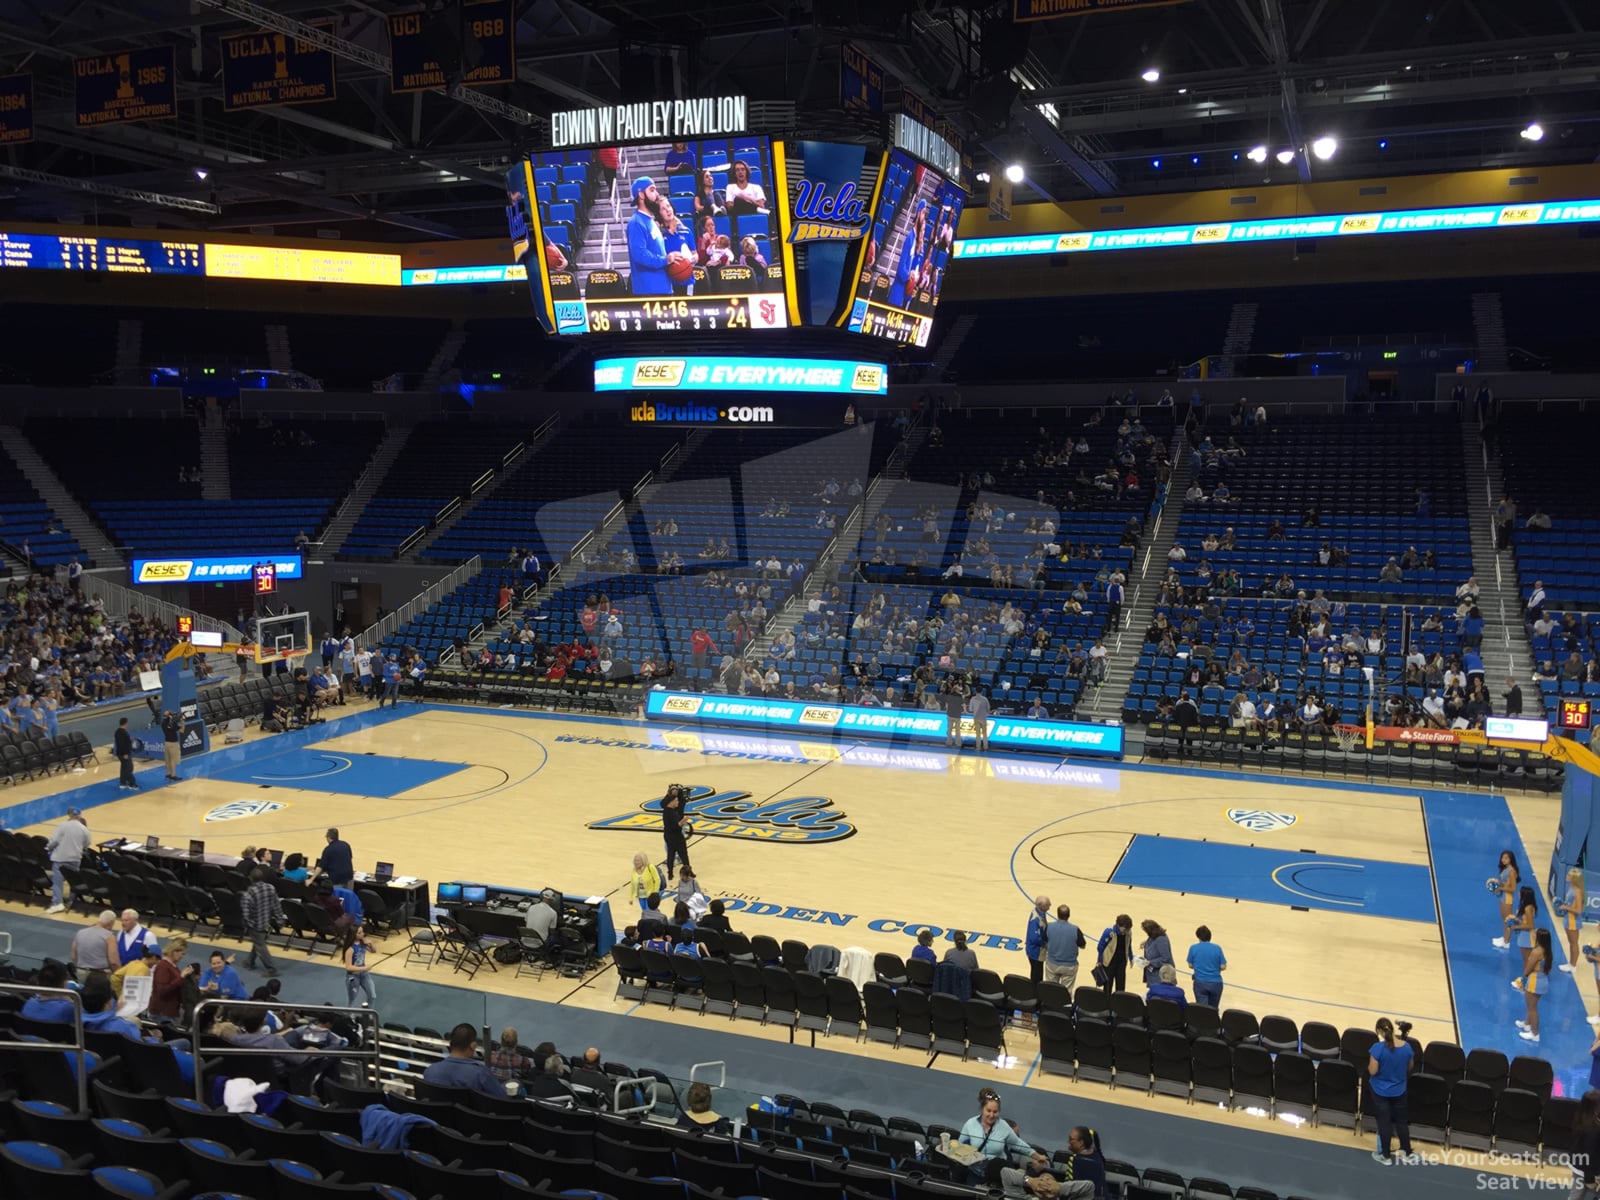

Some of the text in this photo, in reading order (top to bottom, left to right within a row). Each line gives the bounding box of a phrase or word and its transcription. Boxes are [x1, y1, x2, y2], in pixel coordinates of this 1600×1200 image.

[472, 18, 504, 39] 968
[228, 36, 271, 60] UCLA
[77, 56, 114, 77] UCLA
[137, 66, 166, 86] 1965
[402, 70, 445, 88] NATIONAL
[232, 83, 326, 105] NATIONAL CHAMPIONS
[79, 103, 171, 126] NATIONAL CHAMPIONS
[551, 95, 745, 147] EDWIN W PAULEY PAVILION
[795, 179, 865, 222] Ucla
[794, 223, 861, 241] BRUINS
[590, 310, 610, 331] 36
[643, 301, 689, 319] 14:16
[726, 306, 748, 328] 24
[620, 320, 642, 331] 0 3
[656, 320, 675, 331] Period
[693, 317, 716, 329] 3 3
[687, 365, 845, 386] IS EVERYWHERE
[144, 564, 189, 577] KEYES
[195, 565, 210, 576] IS
[258, 575, 272, 591] 30
[179, 624, 190, 633] 30
[702, 702, 716, 713] IS
[714, 703, 796, 719] EVERYWHERE
[842, 713, 857, 724] IS
[855, 714, 942, 731] EVERYWHERE
[996, 725, 1010, 736] IS
[1010, 727, 1105, 744] EVERYWHERE
[1565, 712, 1583, 725] 30
[554, 735, 691, 753] WOODEN
[700, 749, 820, 765] COURT
[718, 890, 761, 901] John
